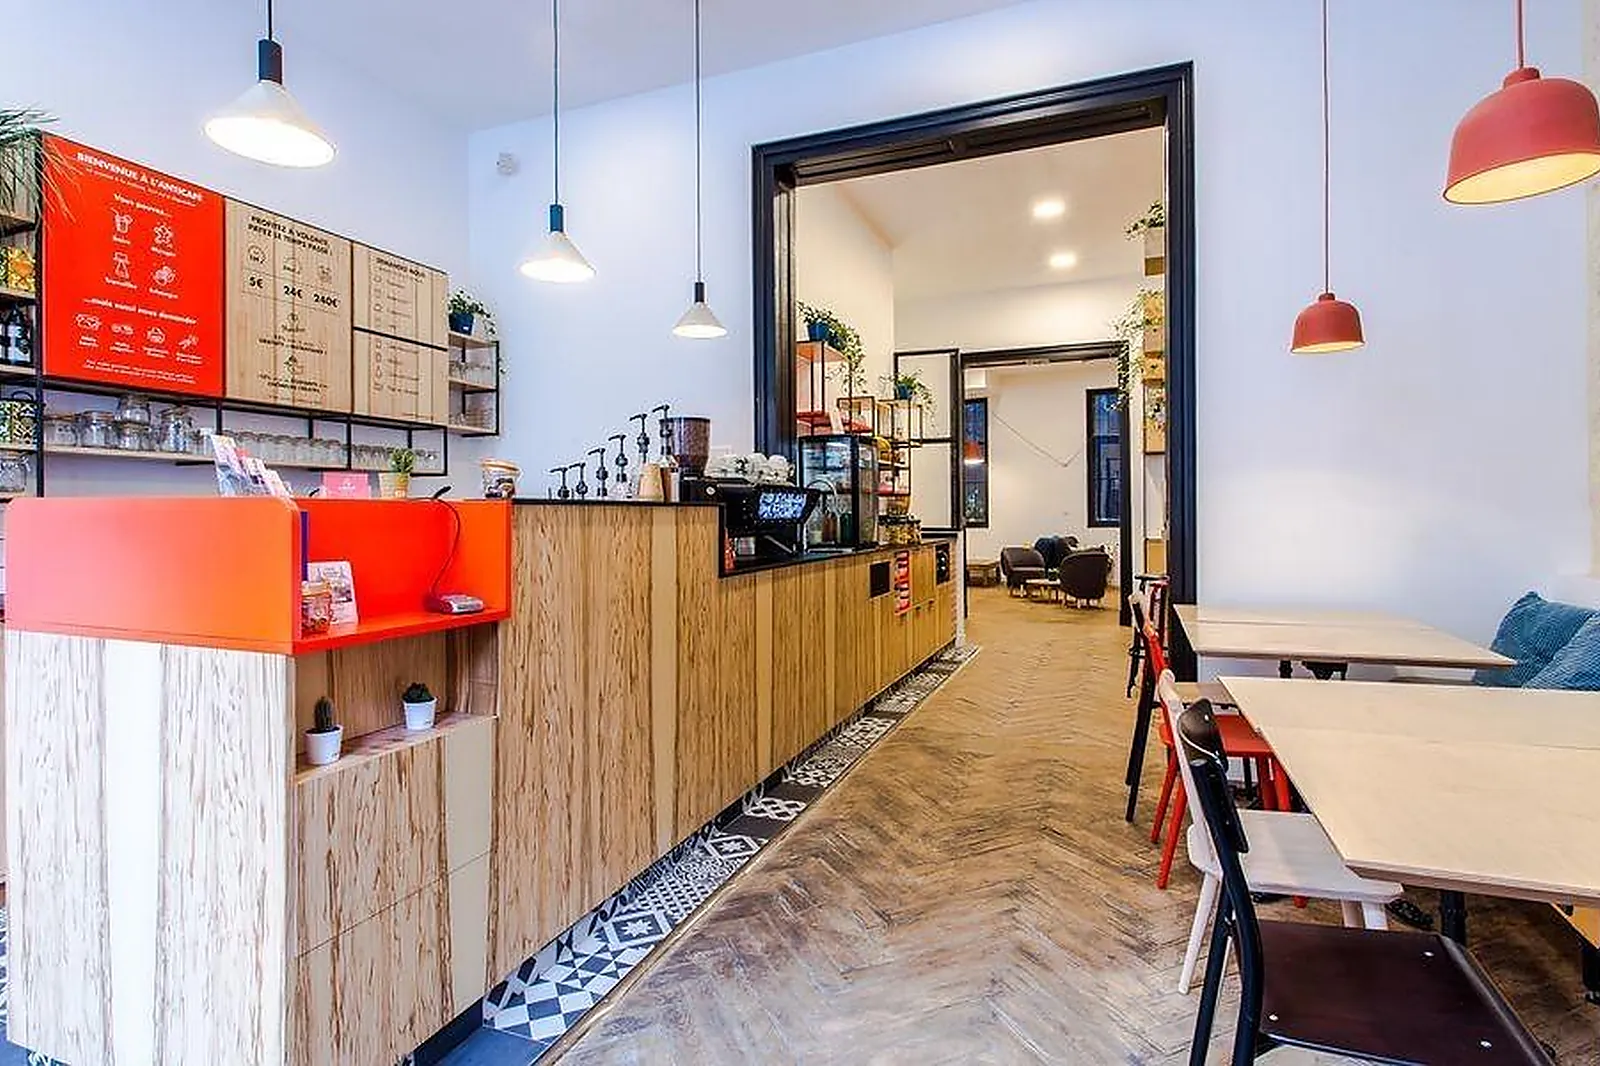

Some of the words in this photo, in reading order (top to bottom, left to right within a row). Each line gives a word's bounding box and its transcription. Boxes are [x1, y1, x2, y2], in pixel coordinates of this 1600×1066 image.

[77, 152, 139, 180] BIENVENUE
[251, 216, 286, 232] PROFITEZ
[249, 276, 263, 289] 5€
[283, 285, 303, 299] 24€
